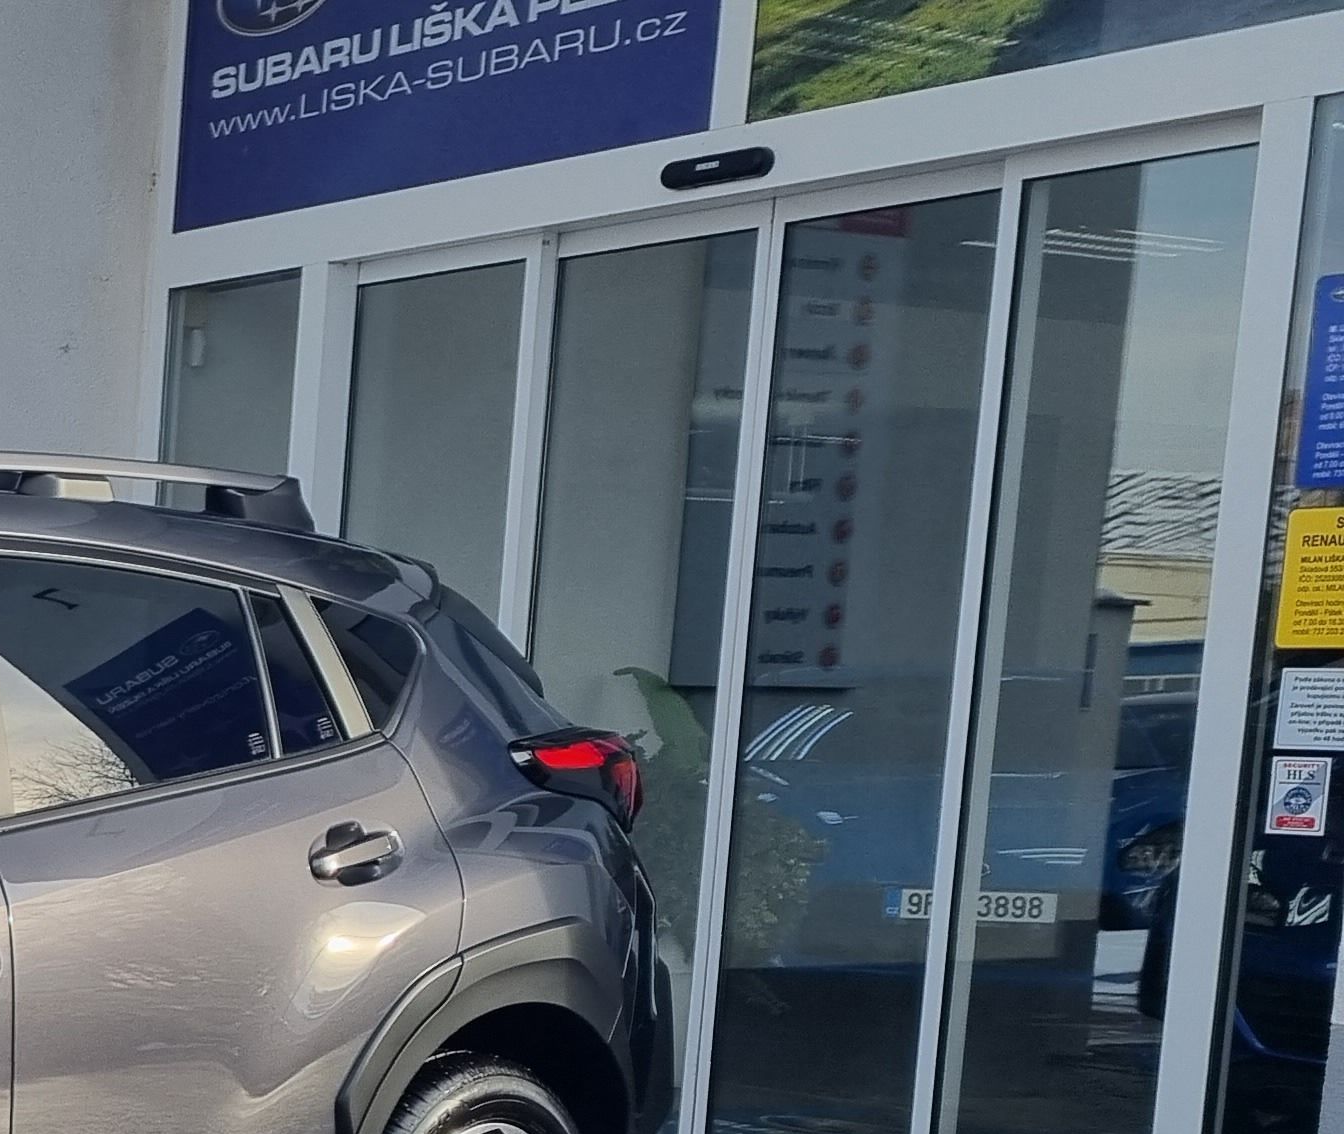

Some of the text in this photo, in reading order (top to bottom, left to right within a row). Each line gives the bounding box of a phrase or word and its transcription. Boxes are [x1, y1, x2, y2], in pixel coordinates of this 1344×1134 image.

[208, 10, 689, 140] www.LISKA-SUBARU.cz
[210, 30, 381, 101] SUBARU
[388, 2, 520, 56] LIŠKA
[977, 894, 1045, 919] 3898
